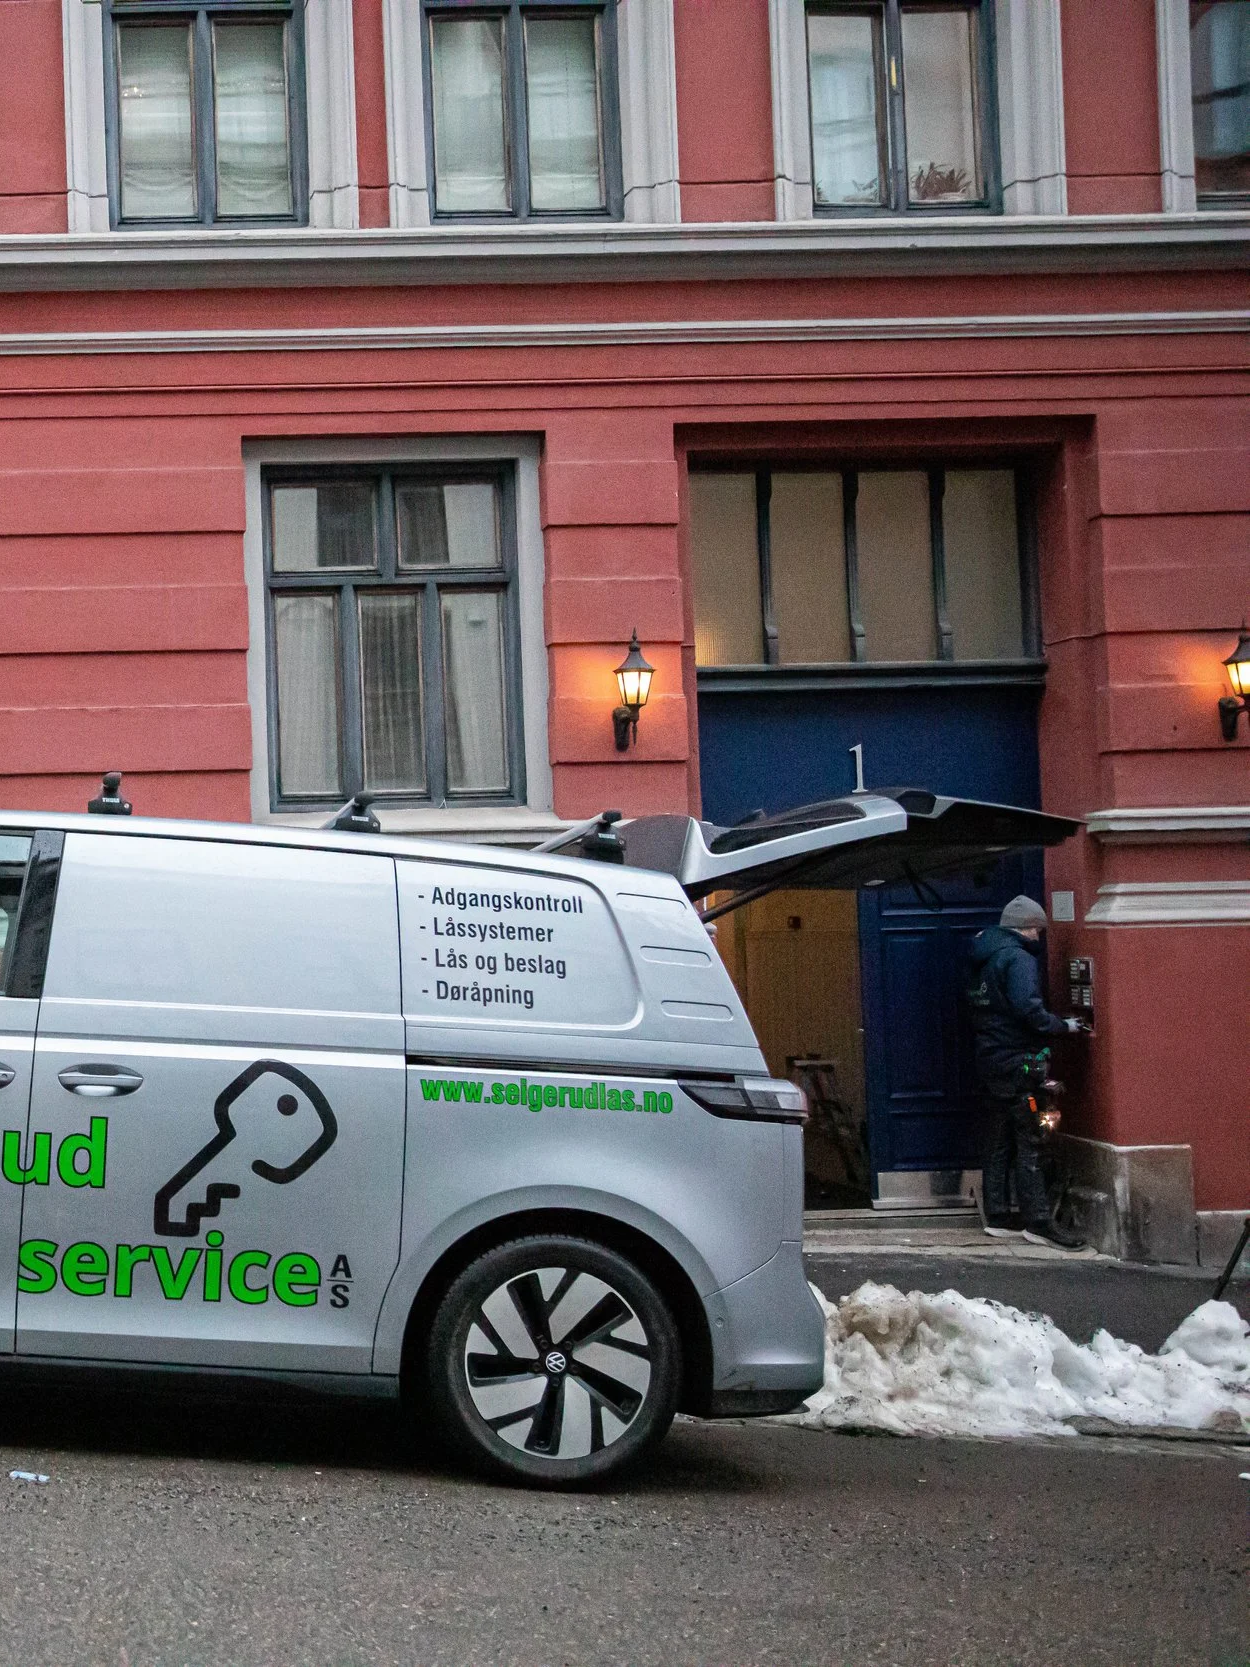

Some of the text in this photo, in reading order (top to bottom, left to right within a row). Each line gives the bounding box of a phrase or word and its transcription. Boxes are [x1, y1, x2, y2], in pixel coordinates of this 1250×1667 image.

[849, 743, 869, 793] 1
[431, 887, 583, 914] Adgangskontroll
[433, 917, 554, 942] Låssystemer
[435, 948, 567, 979] Lås og beslag
[436, 981, 535, 1009] Døråpning
[420, 1078, 674, 1114] www.seigerudlas.no
[17, 1230, 322, 1308] service
